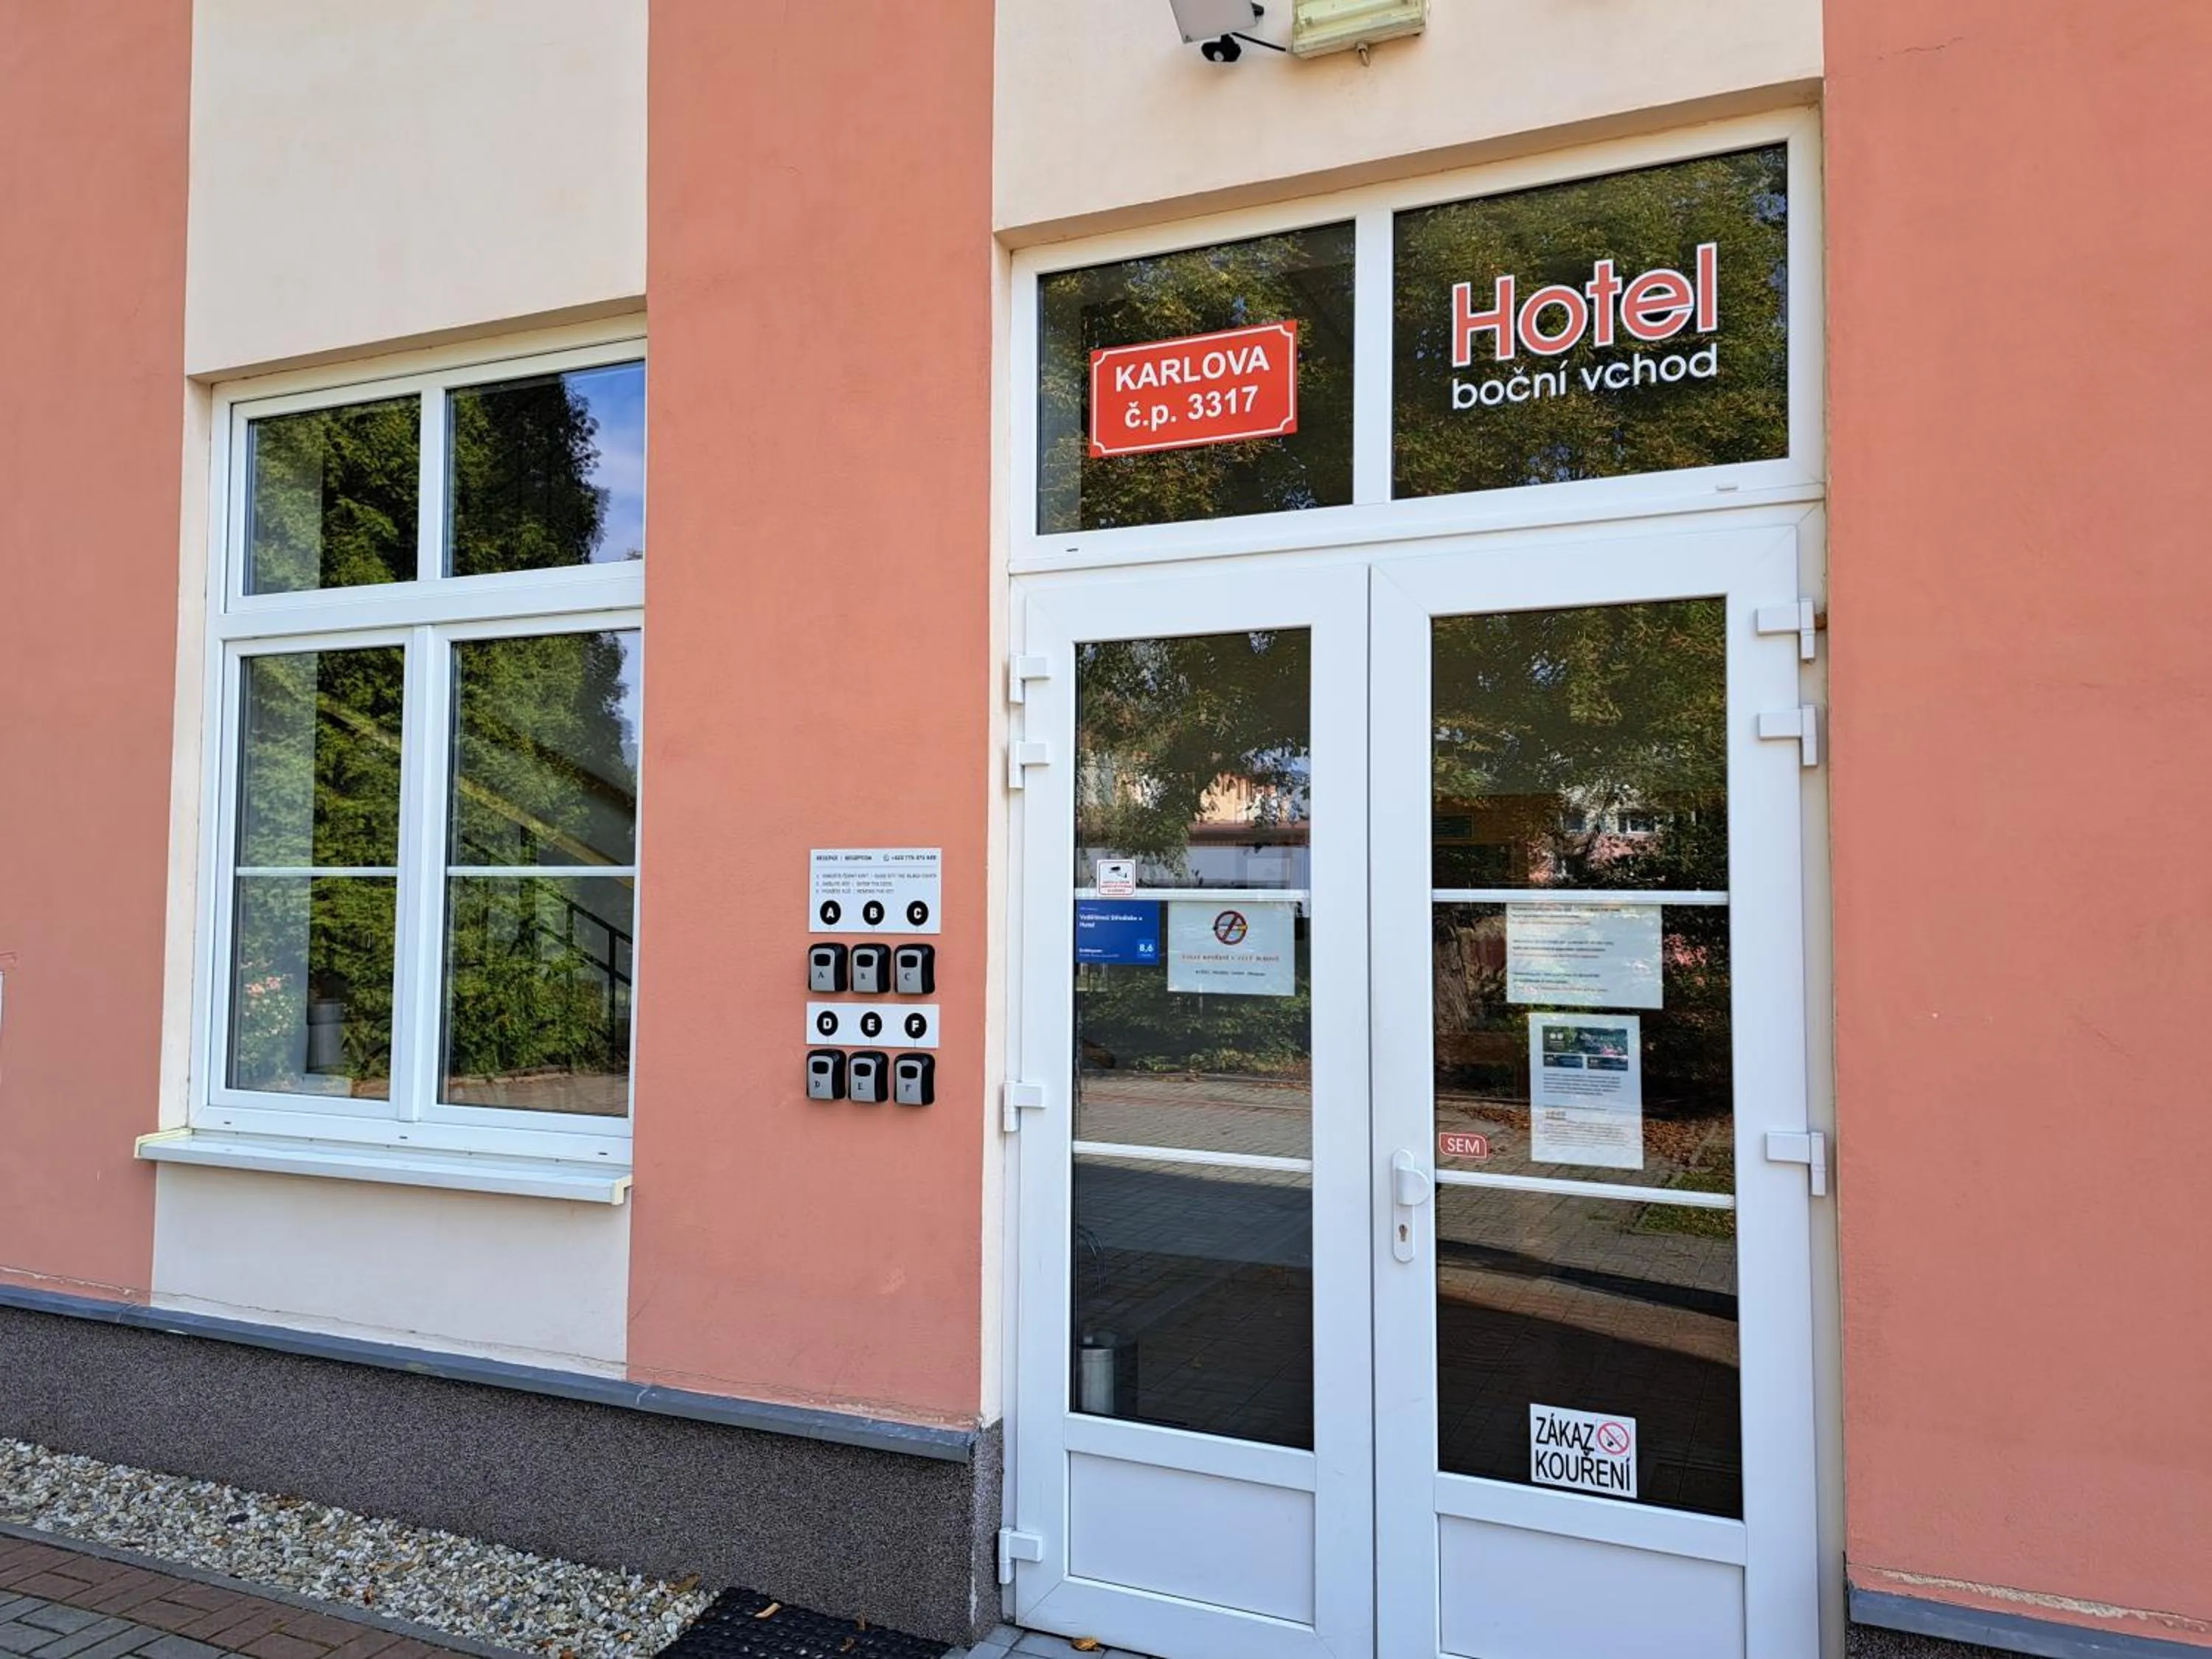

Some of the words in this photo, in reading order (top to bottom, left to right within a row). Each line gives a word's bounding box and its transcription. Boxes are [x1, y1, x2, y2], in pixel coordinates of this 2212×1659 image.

[1452, 243, 1718, 368] Hotel
[1114, 344, 1270, 393] KARLOVA
[1452, 360, 1568, 410] boční
[1580, 344, 1718, 392] vchod
[1124, 400, 1177, 431] č.p.
[1188, 385, 1259, 420] 3317
[826, 908, 835, 918] A
[869, 908, 877, 918] B
[914, 908, 922, 919] C
[1139, 944, 1154, 953] 8,6
[823, 1018, 832, 1029] D
[867, 1019, 875, 1031] E
[911, 1020, 919, 1032] F
[815, 1080, 821, 1088] D
[858, 1082, 863, 1091] E
[1447, 1138, 1481, 1155] SEM
[1535, 1413, 1595, 1453] ZÁKAZ
[1535, 1450, 1630, 1491] KOUŘENÍ
